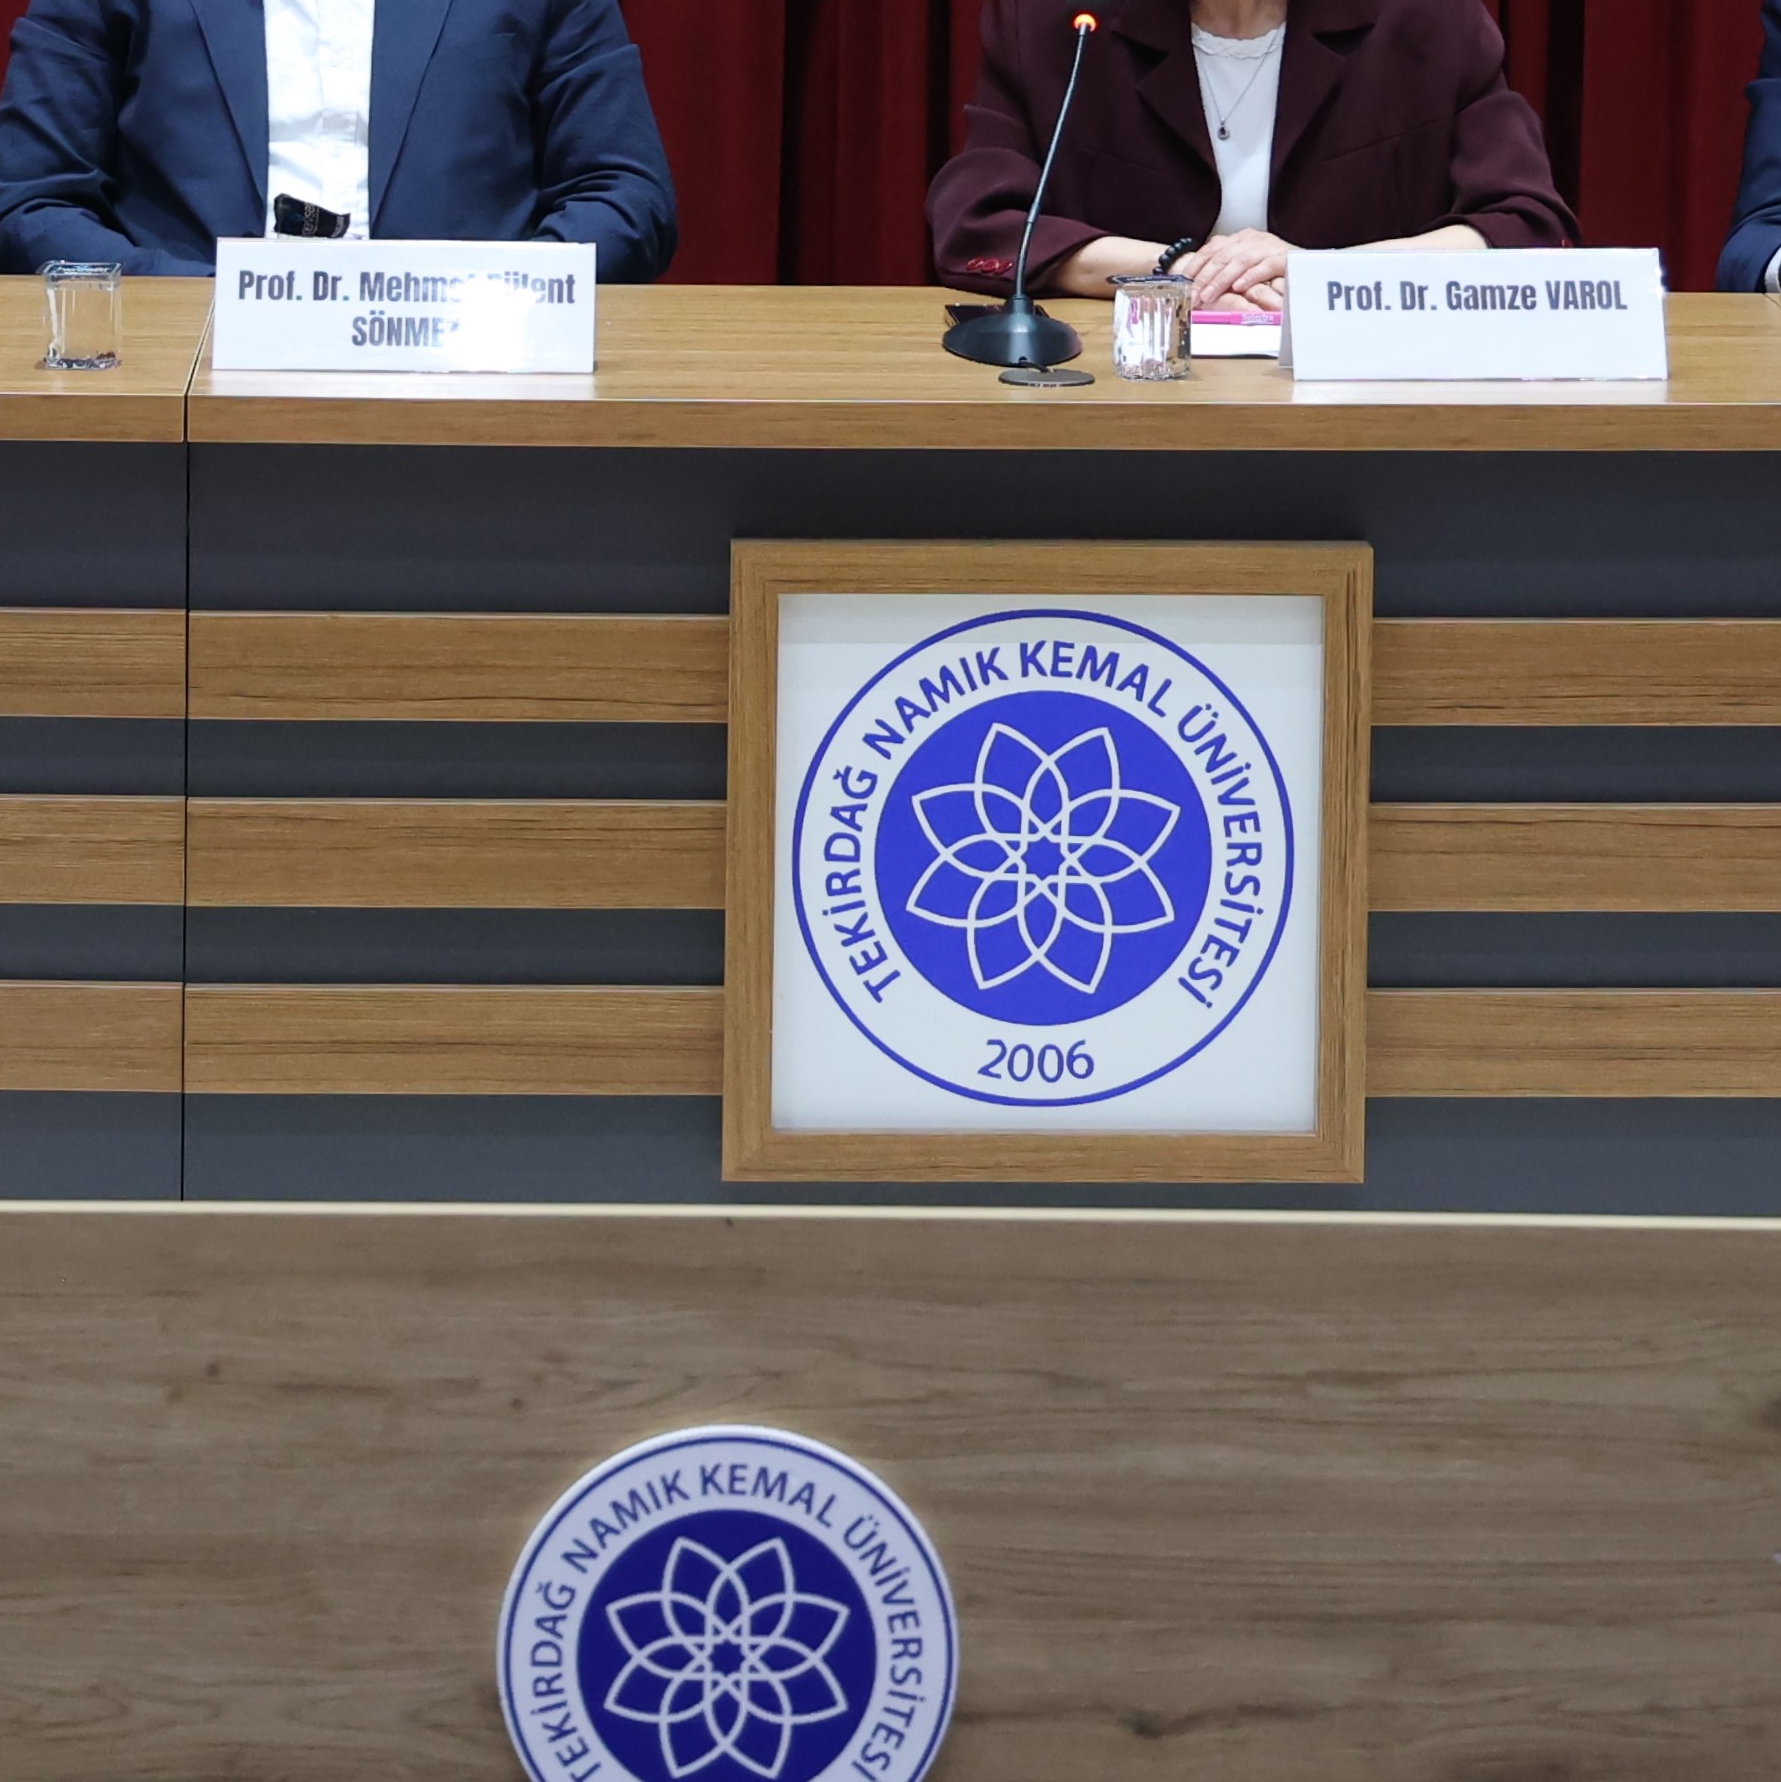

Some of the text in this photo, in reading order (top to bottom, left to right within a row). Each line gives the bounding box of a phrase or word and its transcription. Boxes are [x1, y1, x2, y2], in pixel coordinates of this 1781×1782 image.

[238, 270, 576, 304] Prof. Dr. Mehm ülent
[1327, 280, 1628, 311] Prof. Dr. Gamze VAROL
[821, 639, 1265, 1009] TEKİRDAĞ NAMIK KEMAL ÜNİVERSİTESİ
[977, 1038, 1095, 1084] 2006
[560, 1469, 691, 1574] NAMIK
[699, 1463, 837, 1529] KEMAL
[530, 1580, 602, 1782] TEKİRDAĞ
